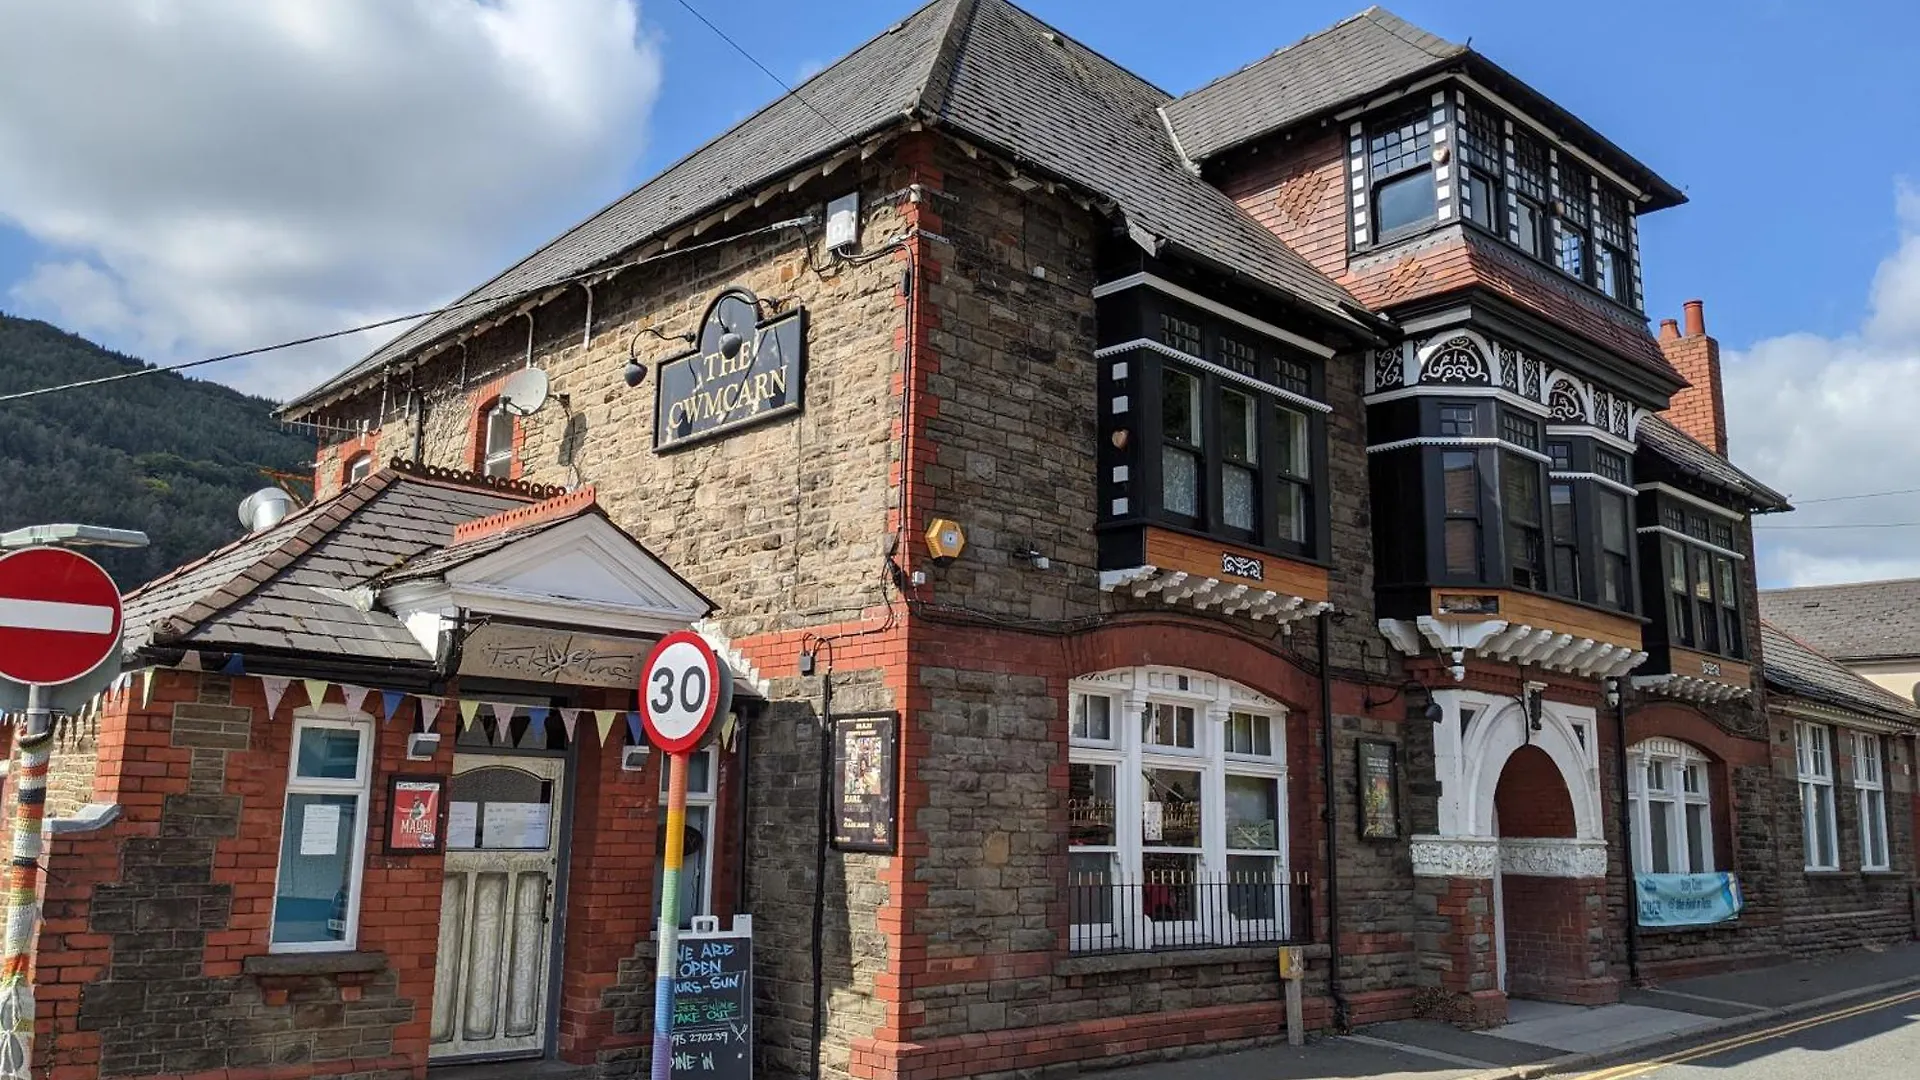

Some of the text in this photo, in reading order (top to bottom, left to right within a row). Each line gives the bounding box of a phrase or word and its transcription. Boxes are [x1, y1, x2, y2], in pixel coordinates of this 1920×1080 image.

[704, 341, 750, 382] THE
[668, 366, 788, 429] CWMCARN
[651, 665, 706, 714] 30
[701, 943, 734, 958] ARE
[680, 959, 721, 977] OPEN
[706, 1009, 729, 1020] OUT
